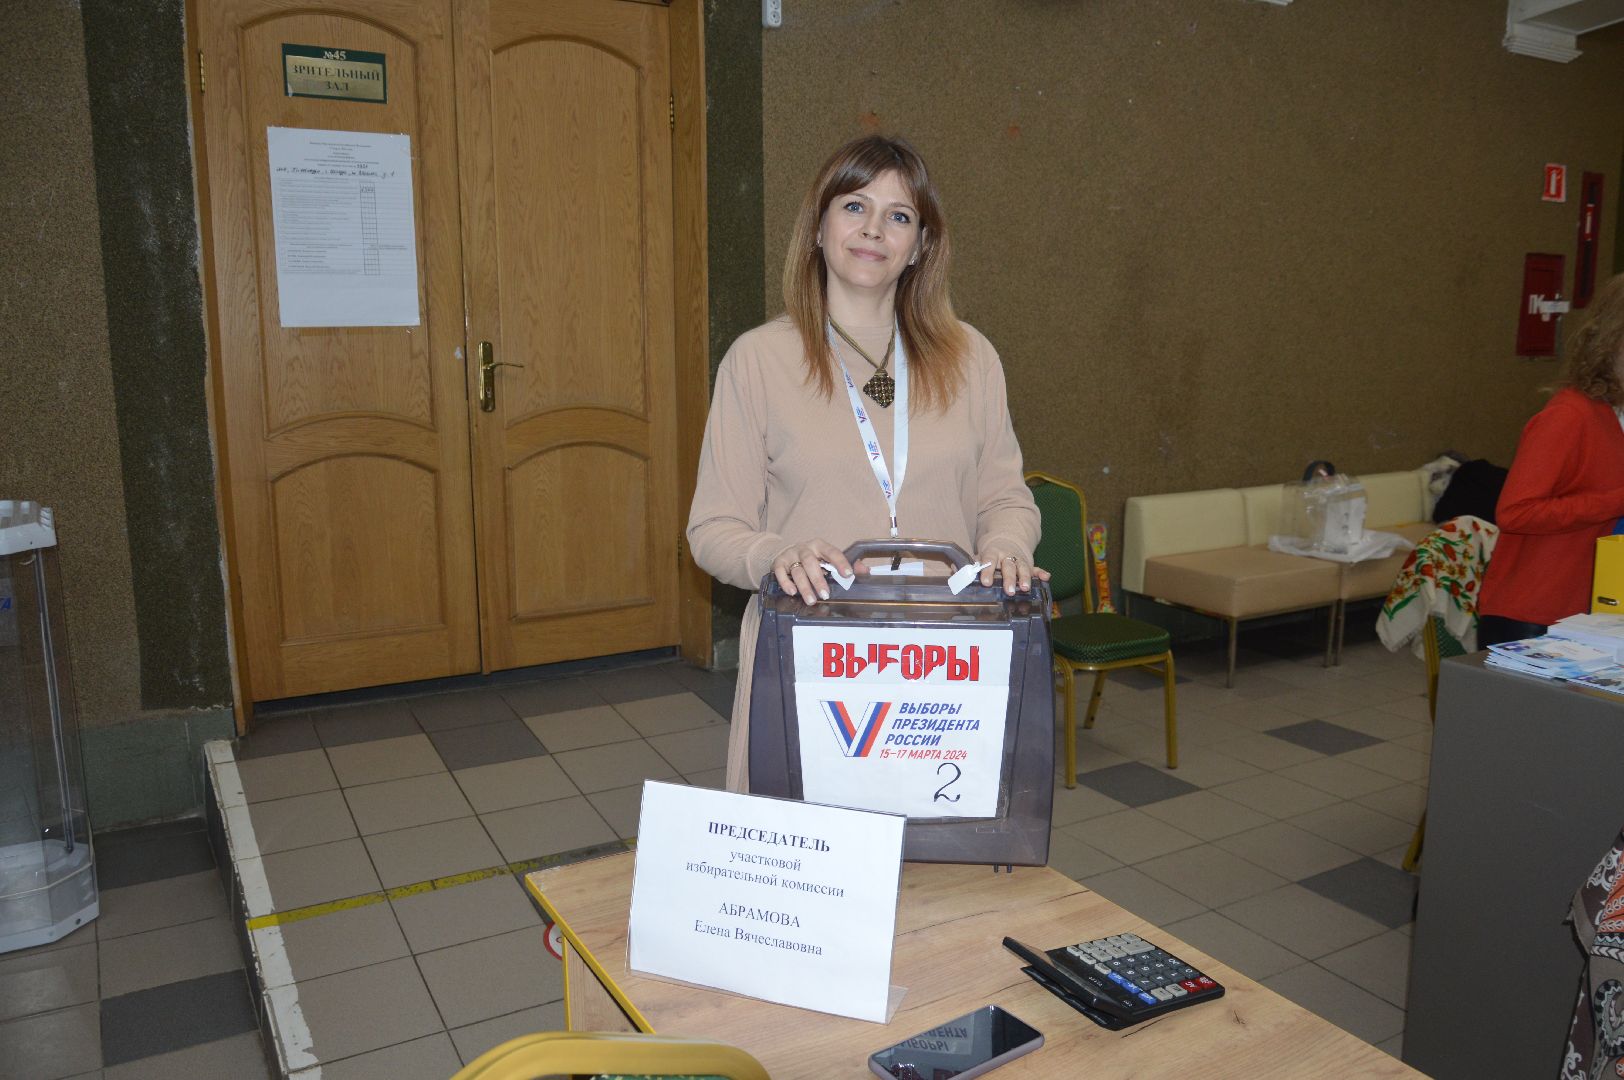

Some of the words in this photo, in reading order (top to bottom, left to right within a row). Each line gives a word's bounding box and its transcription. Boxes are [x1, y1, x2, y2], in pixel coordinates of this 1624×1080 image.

[323, 50, 346, 60] №45
[293, 64, 380, 80] ЗРИТЕЛЬНЫЙ
[326, 81, 349, 91] ЗАЛ
[822, 642, 980, 682] ВЫБОРЫ
[899, 702, 963, 715] ВЫБОРЫ
[892, 718, 980, 732] ПРЕЗИДЕНТА
[884, 734, 942, 746] РОССИИ
[907, 750, 942, 760] МАРТА
[943, 750, 968, 760] 2024
[933, 762, 962, 803] 2
[708, 821, 831, 852] ПРЕДСЕДАТЕЛЬ
[728, 850, 801, 872] участковой
[686, 861, 778, 887] избирательной
[781, 878, 845, 898] комиссии
[718, 901, 801, 928] АБРАМОВА
[694, 919, 731, 938] Елена
[734, 927, 823, 956] Вячеславовна
